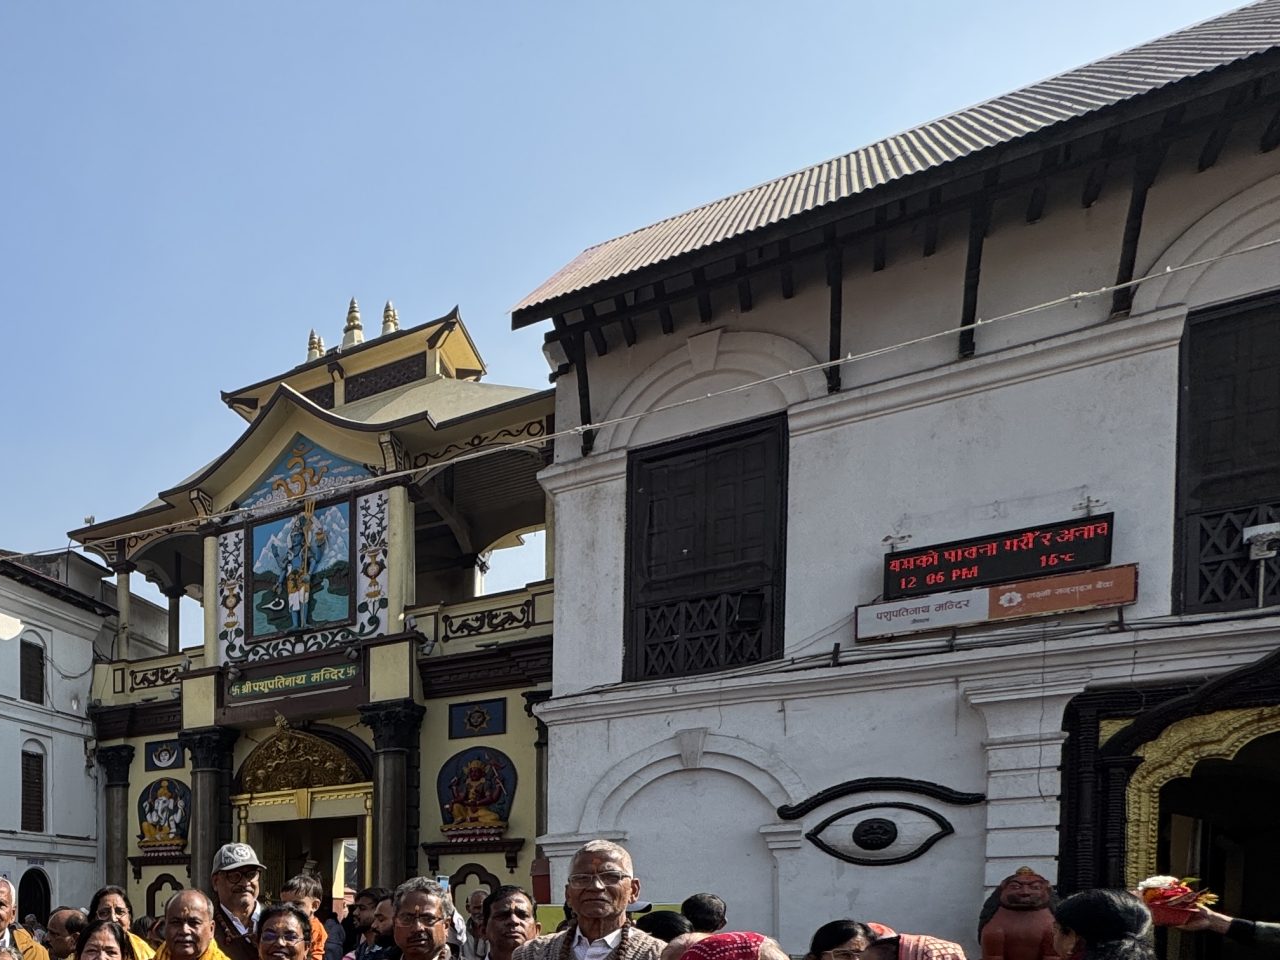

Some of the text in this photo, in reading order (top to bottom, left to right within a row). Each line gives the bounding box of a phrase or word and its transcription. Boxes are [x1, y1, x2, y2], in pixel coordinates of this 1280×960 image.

[900, 576, 917, 589] 12
[952, 565, 978, 580] PM
[876, 604, 930, 622] पशुपतिनाथ
[934, 599, 970, 613] मन्दिर
[311, 667, 345, 682] मन्दिर
